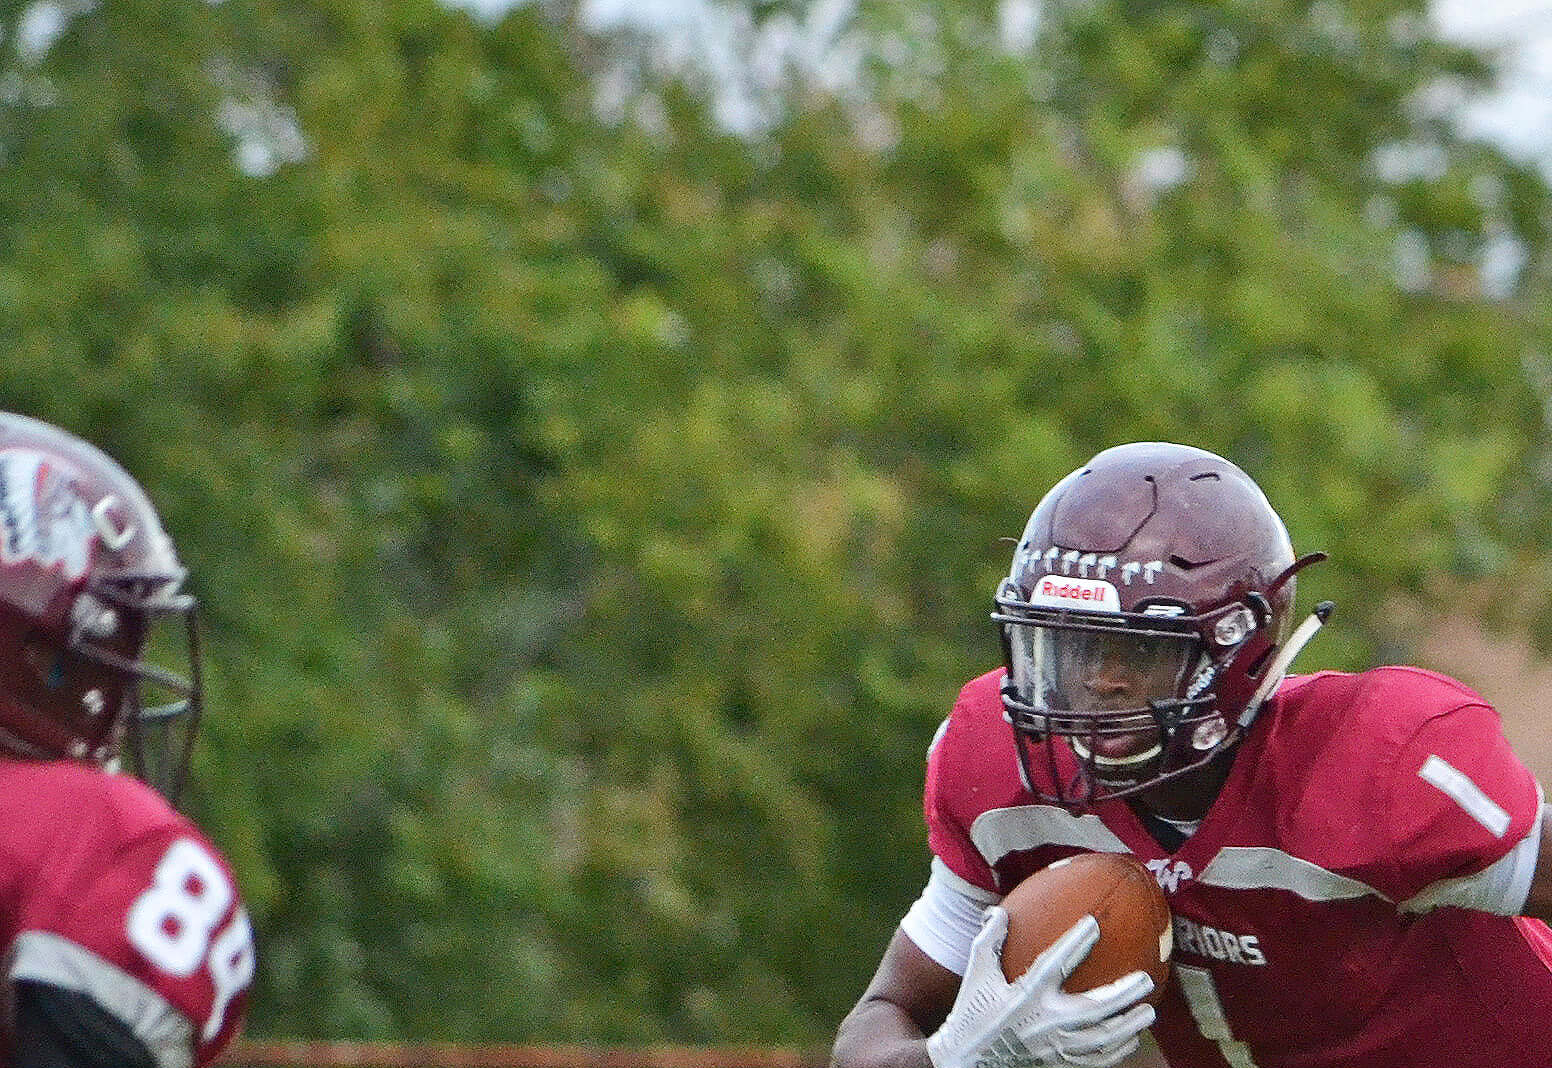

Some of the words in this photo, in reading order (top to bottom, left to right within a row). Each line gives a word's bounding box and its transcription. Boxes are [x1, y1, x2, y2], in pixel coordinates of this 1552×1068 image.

[1042, 581, 1105, 601] Riddell
[1418, 753, 1511, 838] 1
[1173, 914, 1267, 967] RIORS
